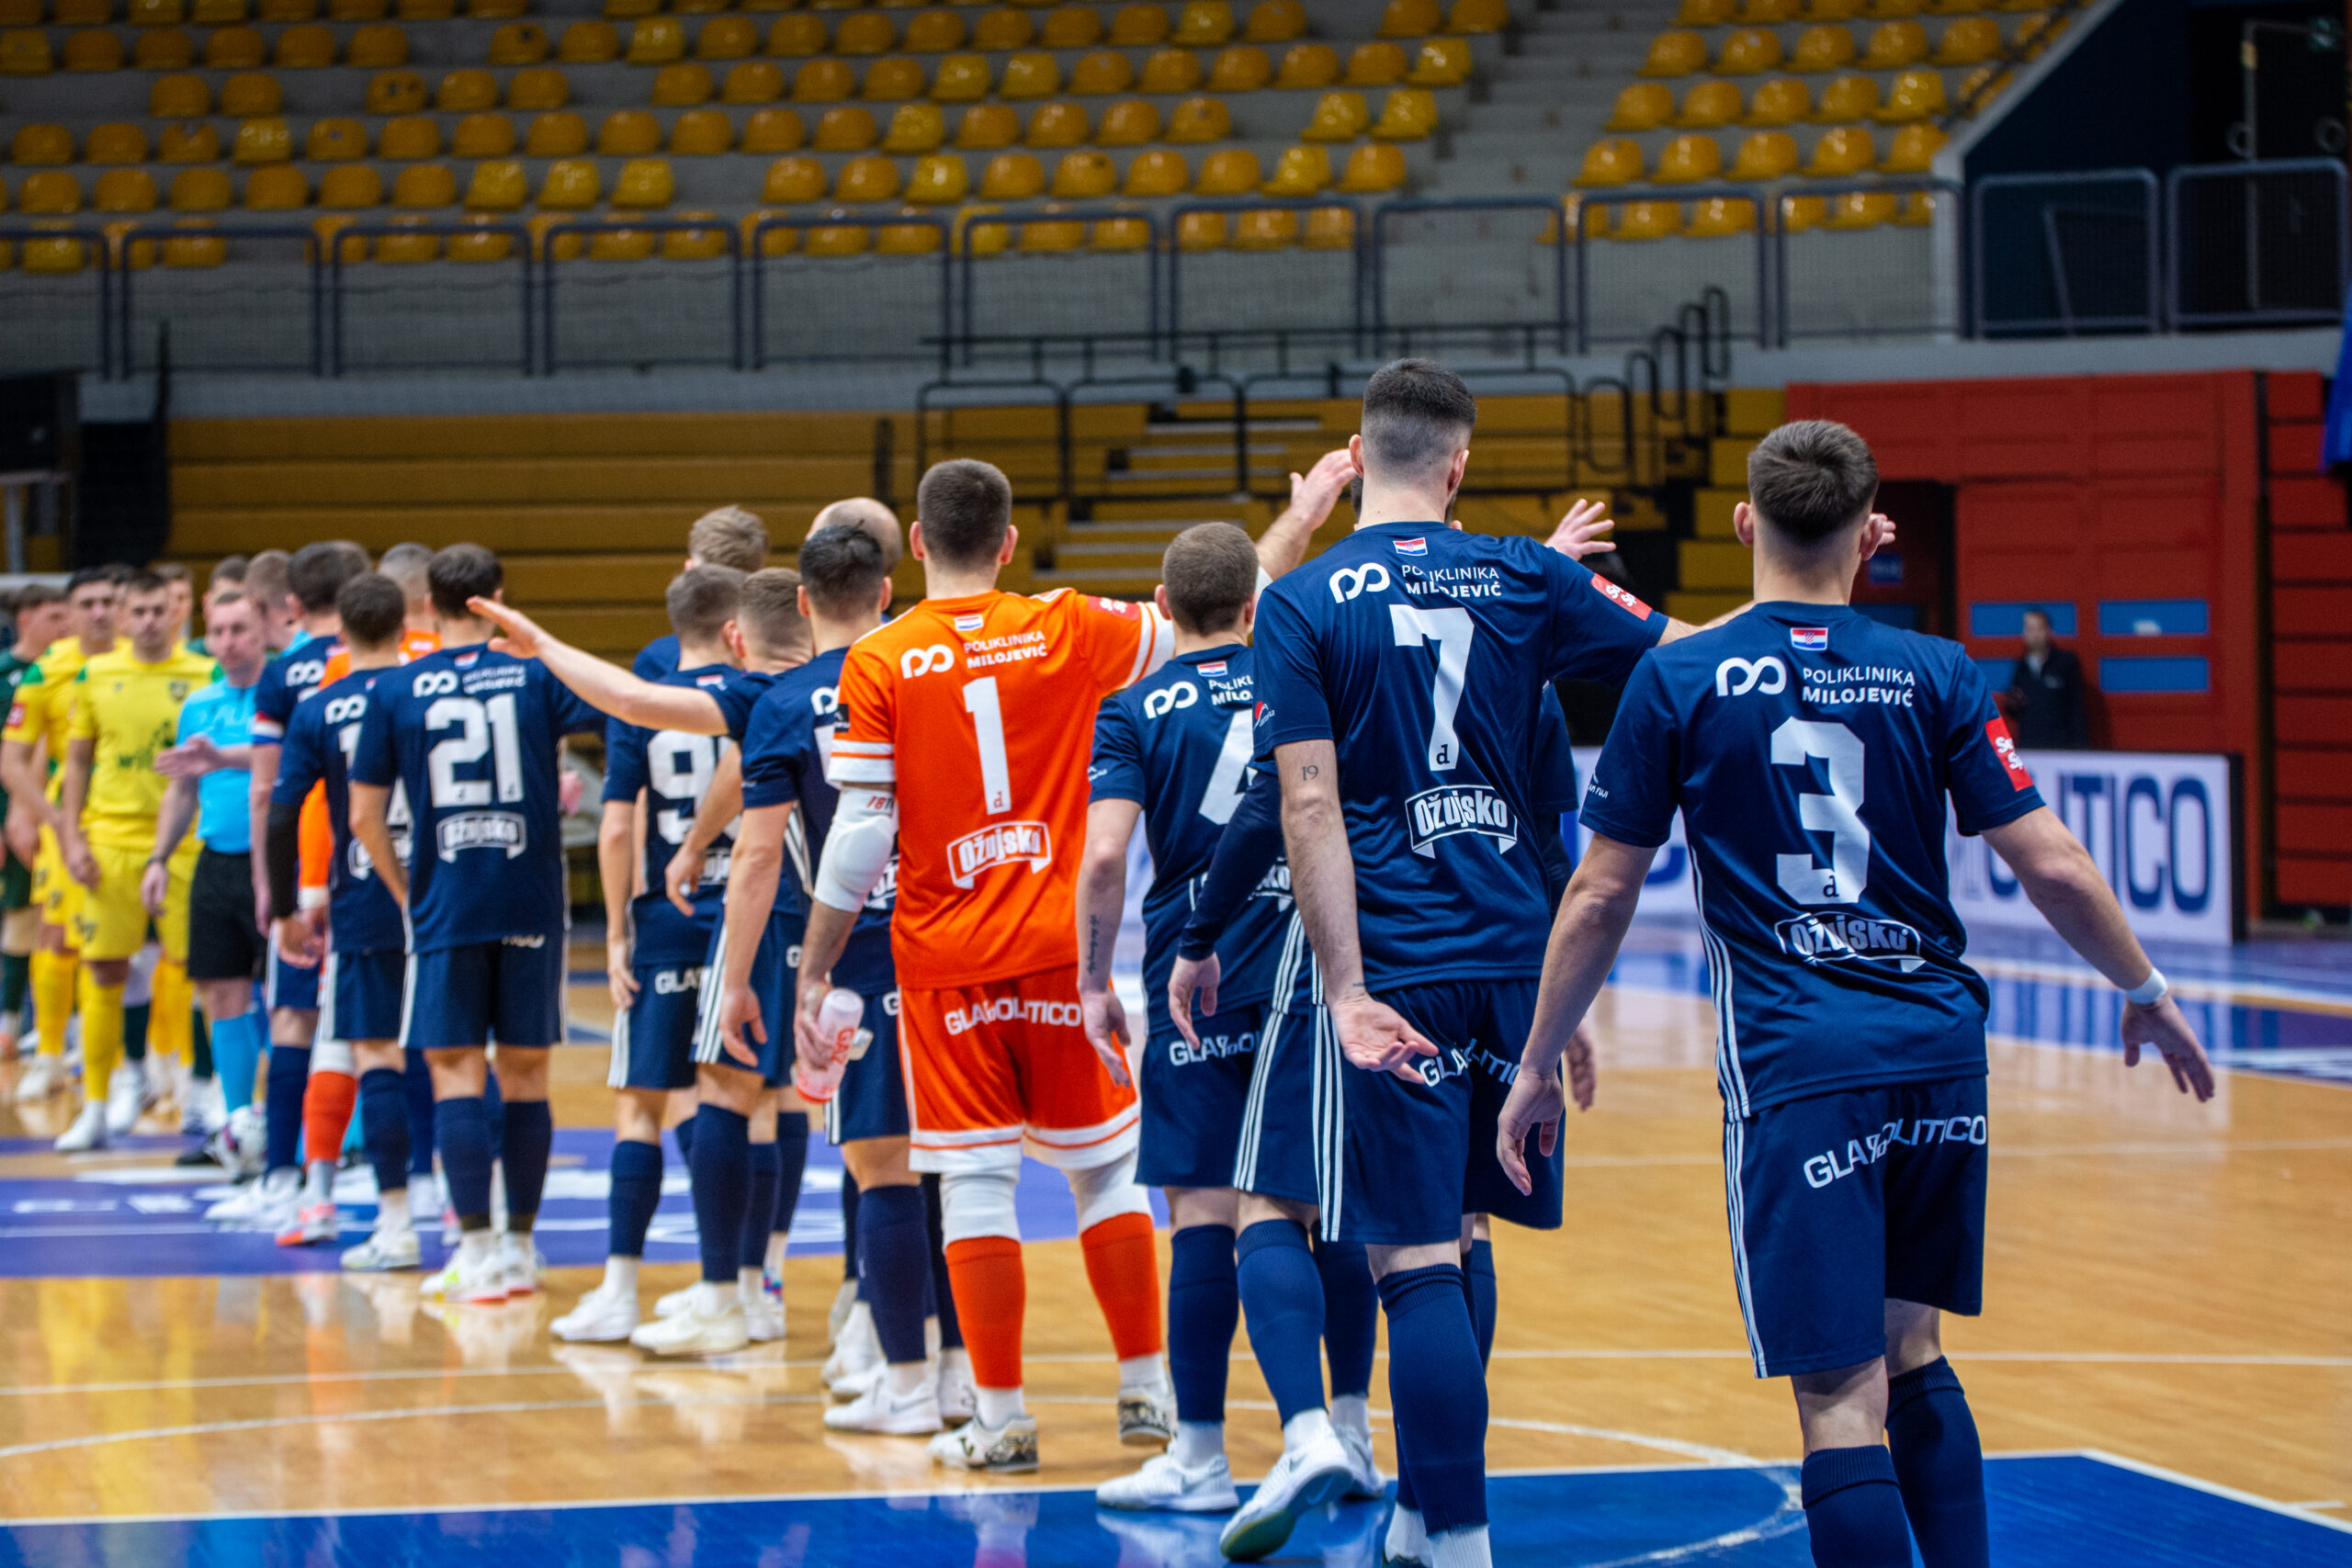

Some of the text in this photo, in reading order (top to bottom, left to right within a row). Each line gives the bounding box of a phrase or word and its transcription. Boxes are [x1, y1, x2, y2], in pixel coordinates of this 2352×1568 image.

[1401, 563, 1500, 584] POIKLINIKA
[963, 630, 1046, 653] POLIKLINIKA
[966, 645, 1048, 669] MILOJEVIĆ
[1207, 674, 1253, 691] POLIKL
[1388, 604, 1475, 771] 7
[1802, 665, 1916, 687] POLIKLINIKA
[1211, 690, 1253, 706] MILO
[1802, 686, 1914, 707] MILOJEVIĆ
[425, 693, 524, 808] 21
[962, 675, 1012, 815] 1
[1302, 764, 1319, 781] 19
[1413, 789, 1509, 837] Ožujsko
[1770, 715, 1871, 906] 3
[958, 826, 1042, 873] Ožujsko
